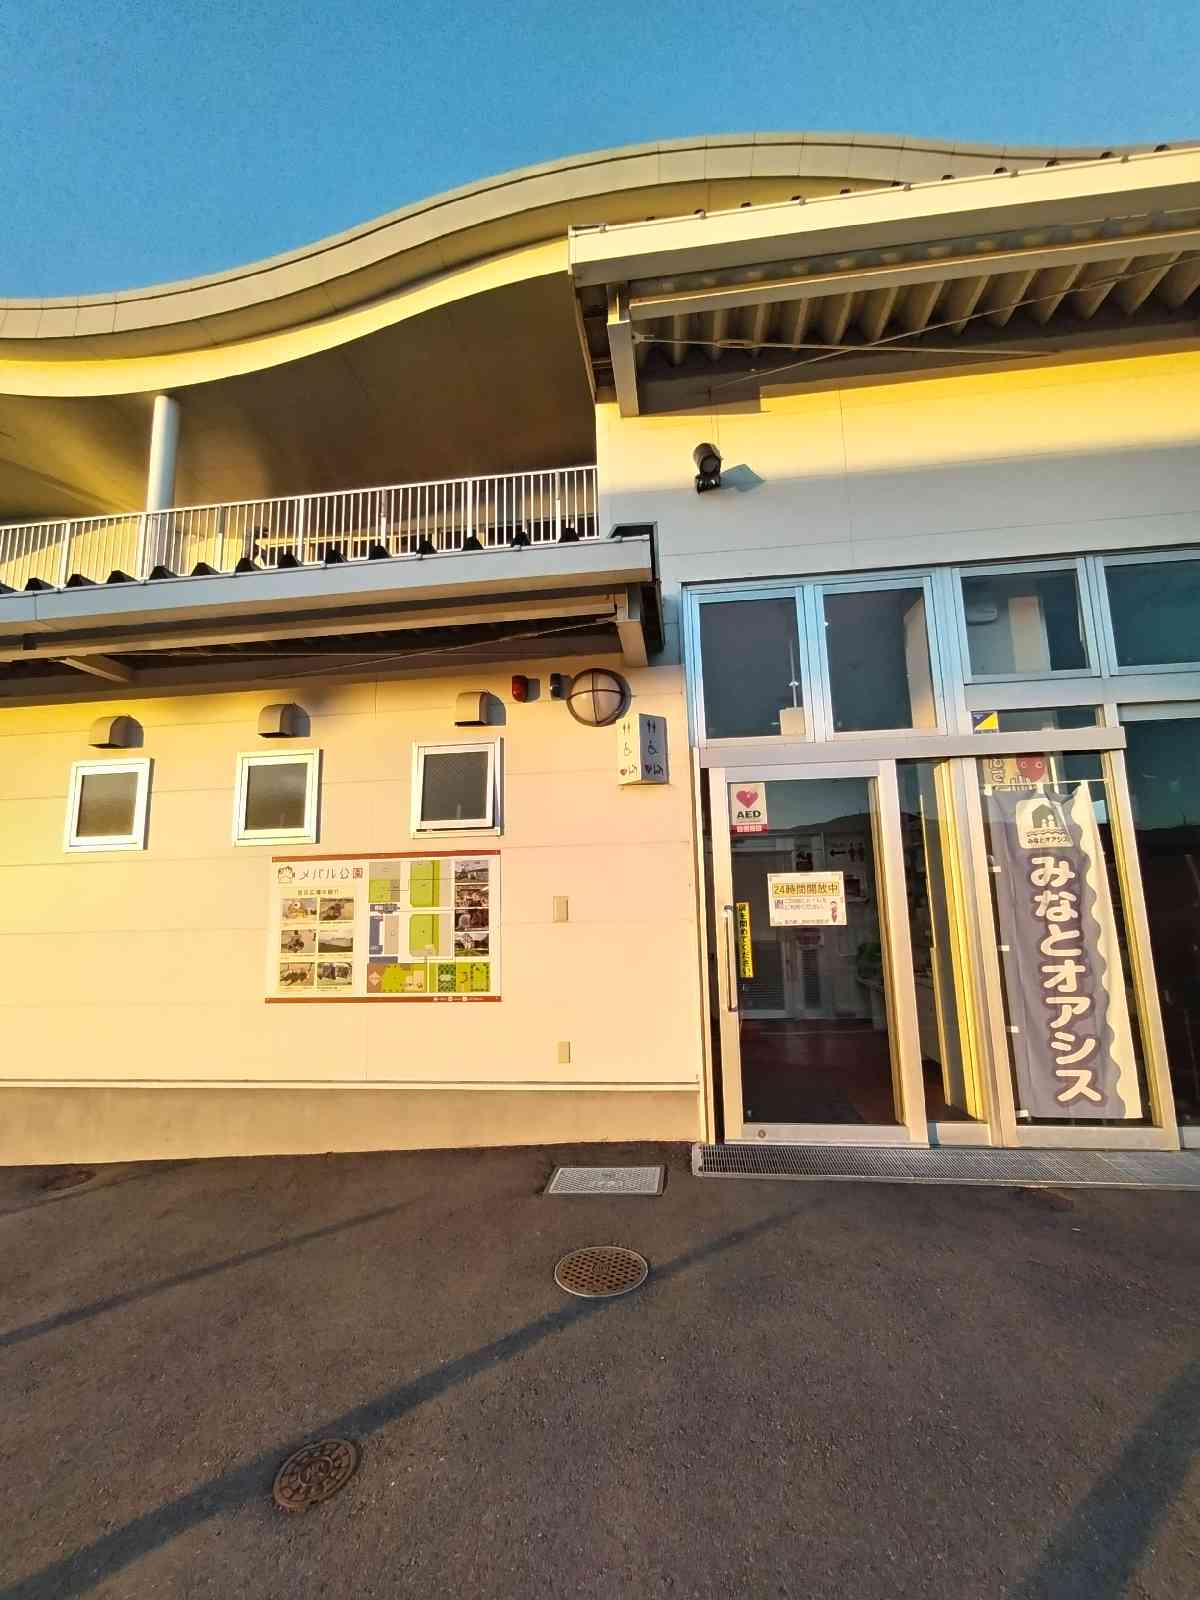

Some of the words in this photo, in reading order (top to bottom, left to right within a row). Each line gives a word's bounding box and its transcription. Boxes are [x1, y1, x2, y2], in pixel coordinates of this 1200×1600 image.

[737, 810, 762, 819] AED
[299, 867, 364, 881] メバル公園
[774, 882, 838, 895] 24時間開放中
[1030, 856, 1102, 1103] みなとオアシス
